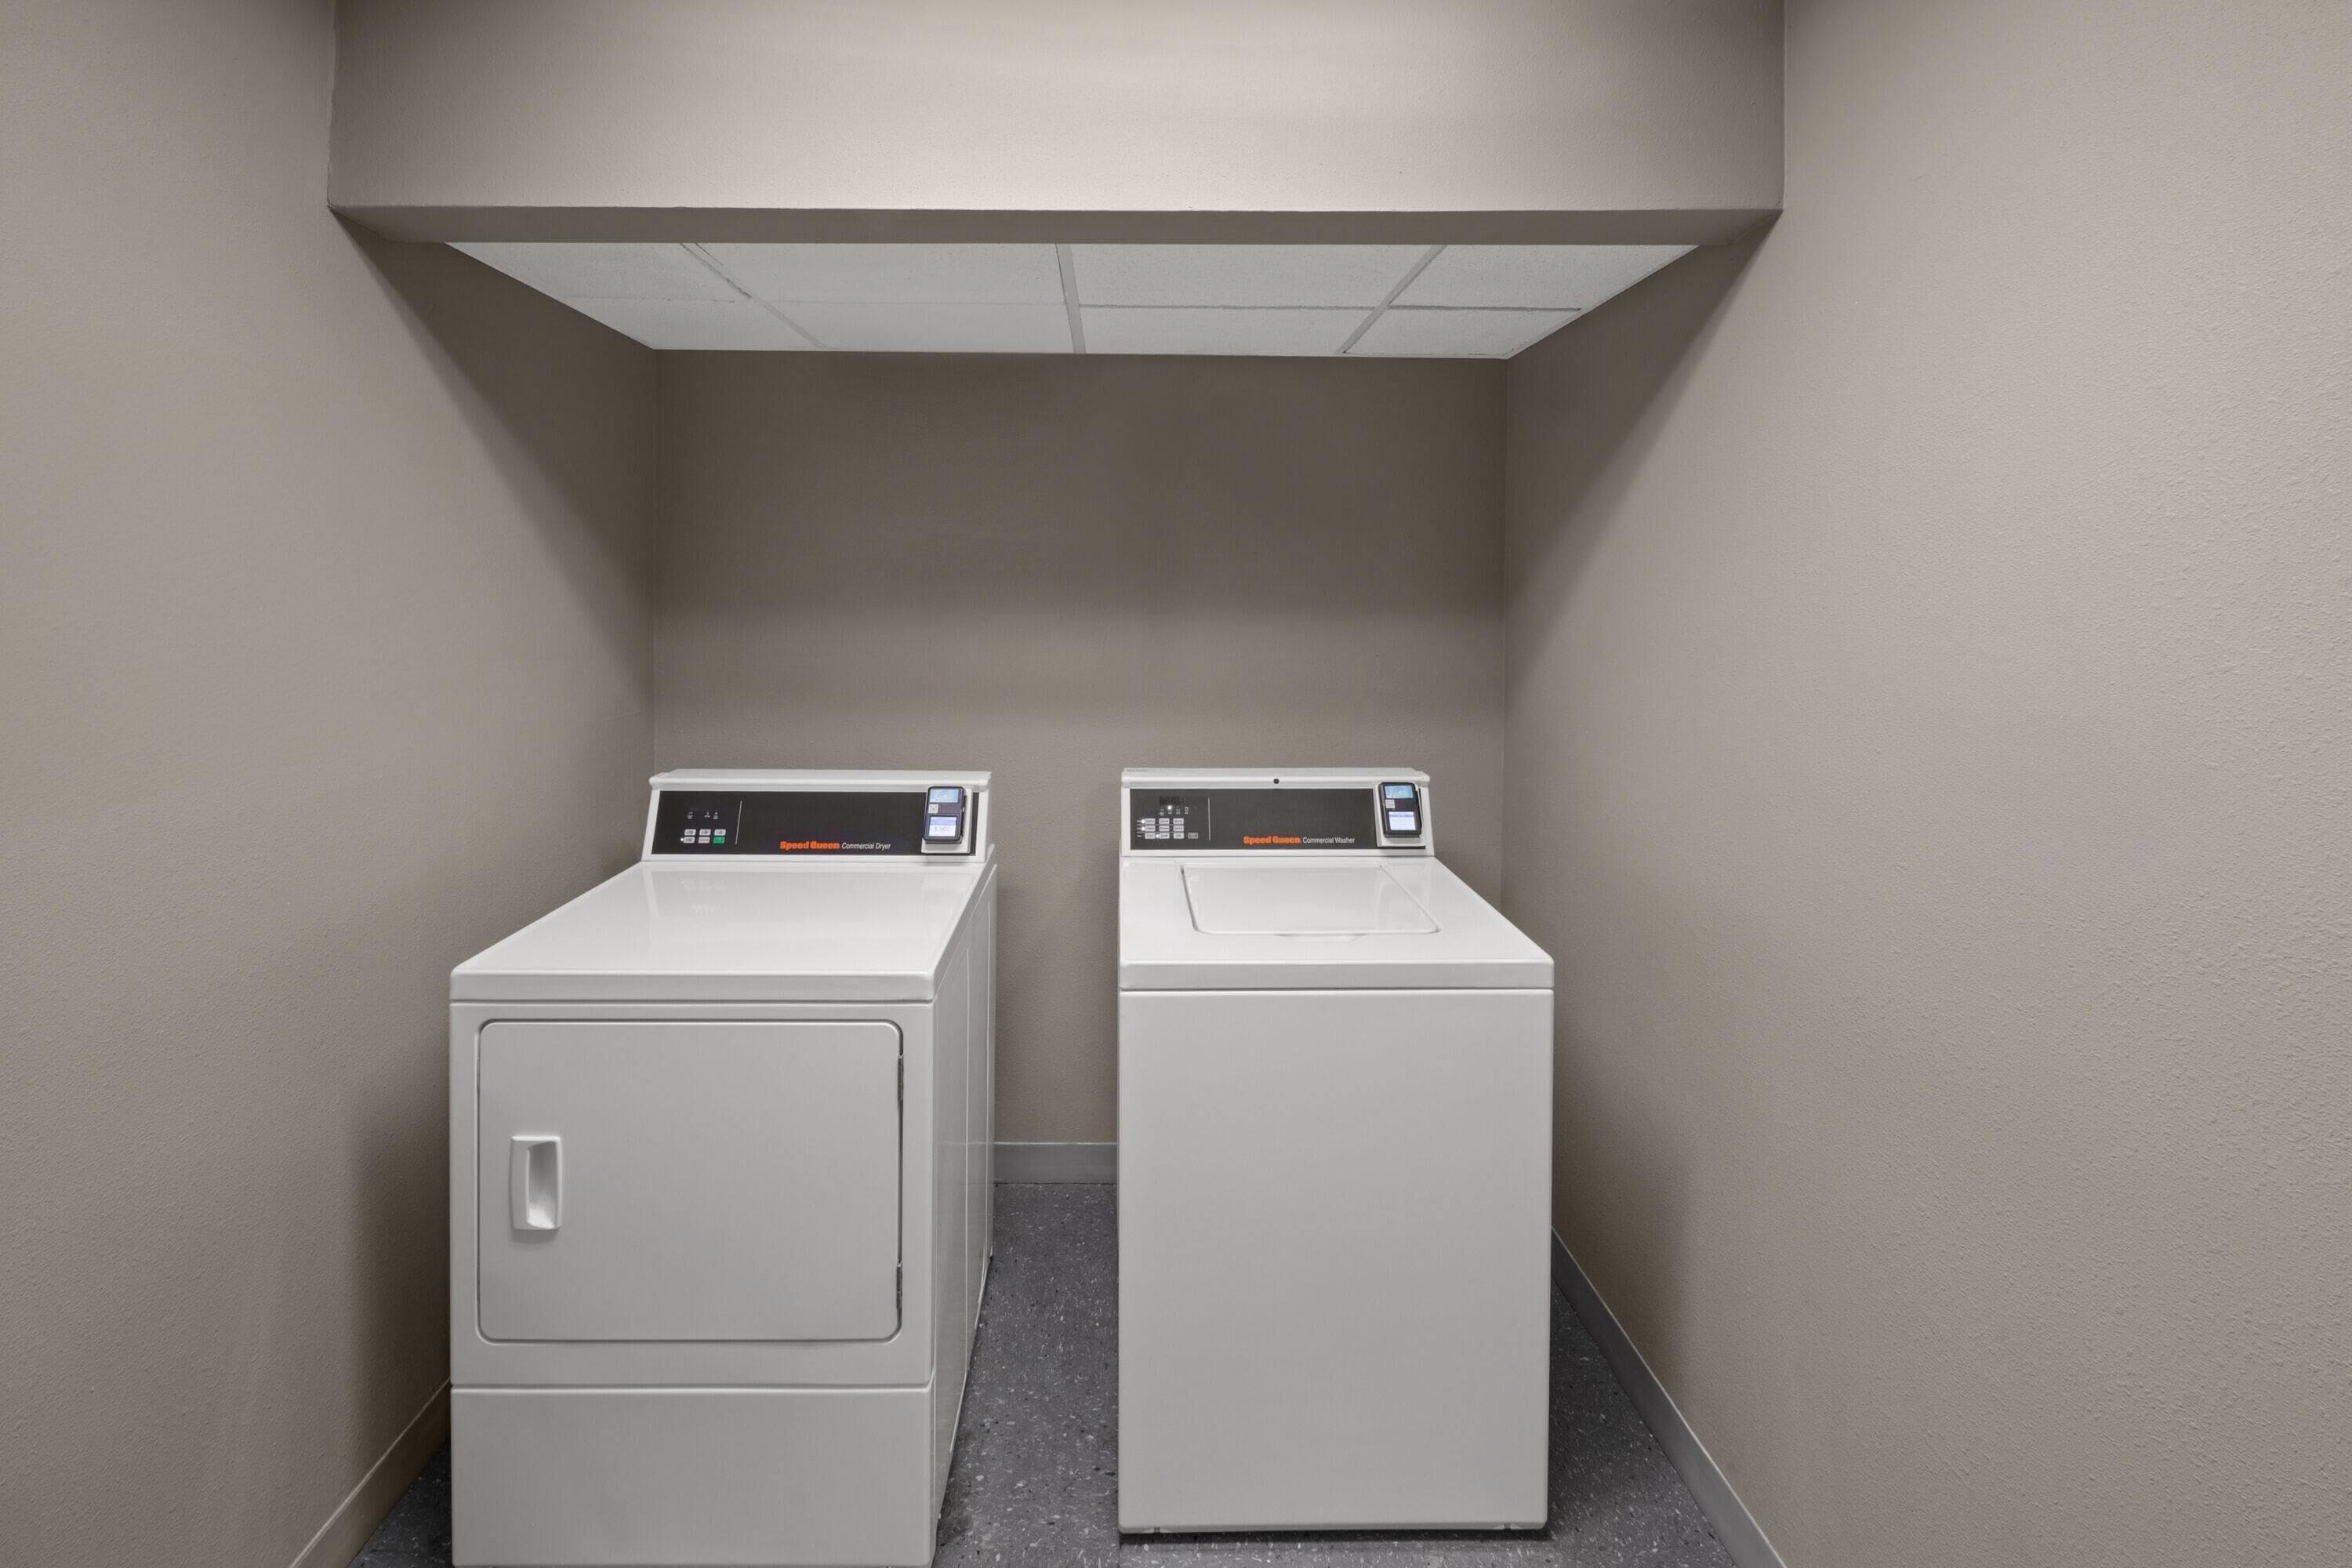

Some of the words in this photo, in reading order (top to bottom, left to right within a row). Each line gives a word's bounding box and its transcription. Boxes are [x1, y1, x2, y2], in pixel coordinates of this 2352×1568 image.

[1243, 836, 1271, 845] Speed
[780, 841, 809, 851] Speed
[876, 842, 891, 851] Dryer
